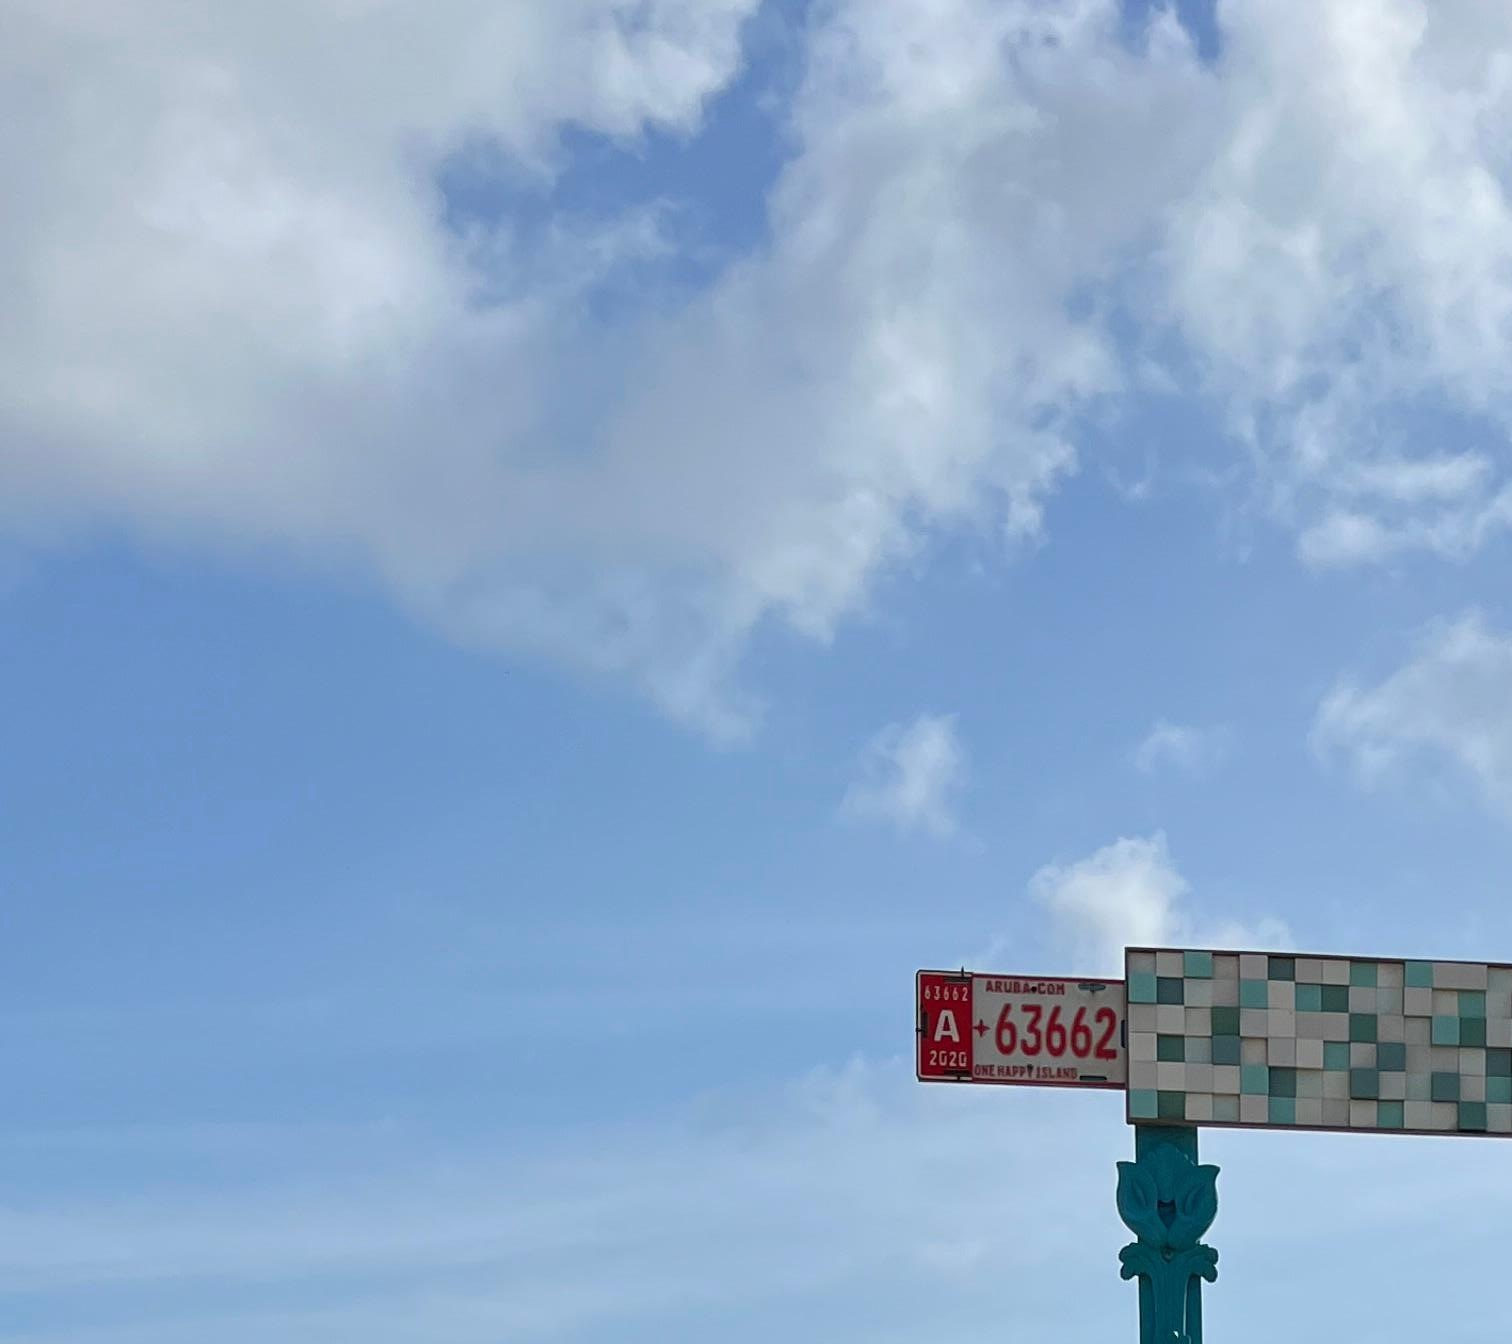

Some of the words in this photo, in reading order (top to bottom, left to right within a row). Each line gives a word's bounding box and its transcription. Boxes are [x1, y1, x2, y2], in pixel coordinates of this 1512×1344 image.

[924, 984, 968, 1001] 63662
[934, 1009, 960, 1043] A
[995, 1003, 1117, 1059] 63662
[929, 1050, 967, 1067] 2020
[974, 1064, 995, 1077] ONE
[997, 1064, 1033, 1078] HAPPY
[1036, 1066, 1078, 1080] ISLAND
